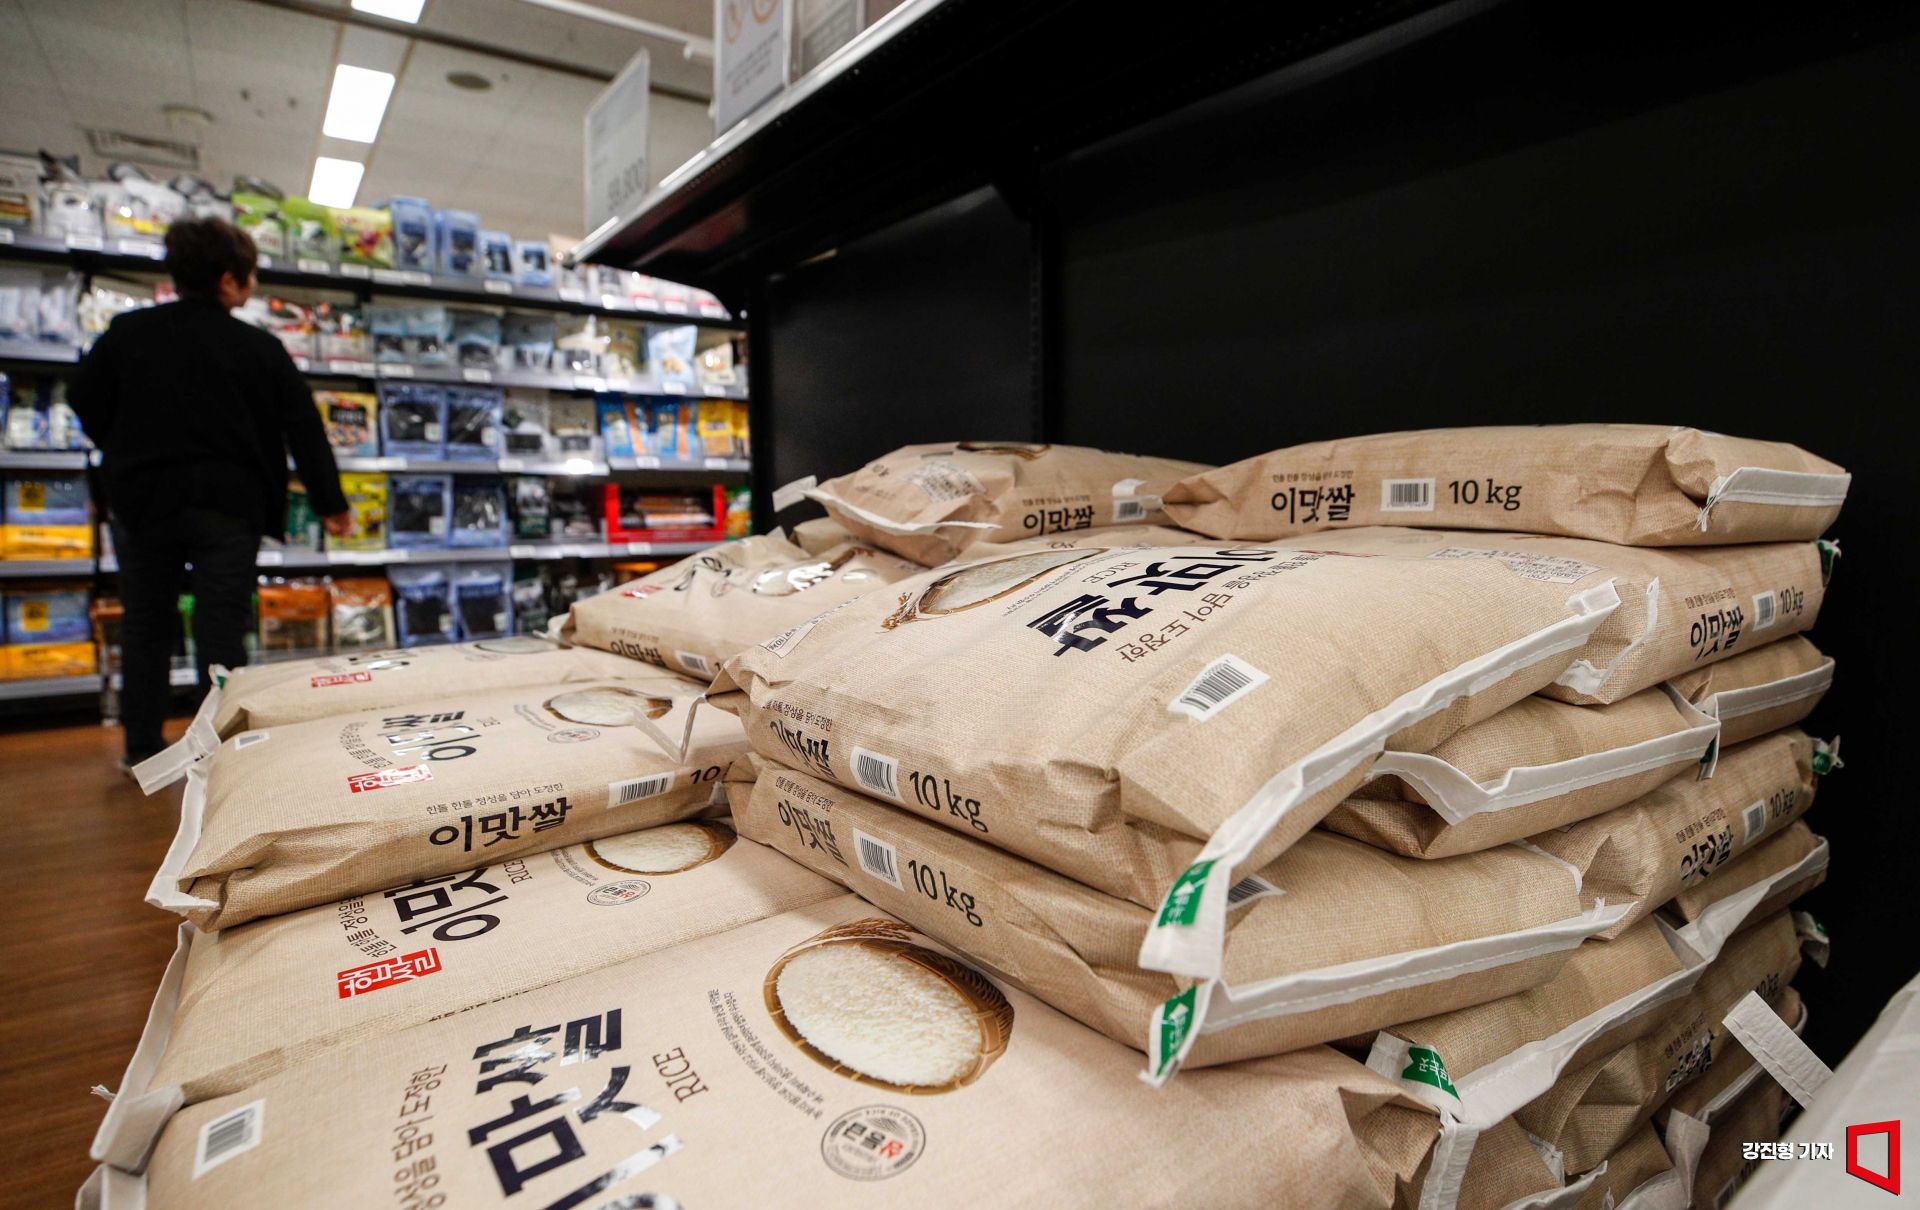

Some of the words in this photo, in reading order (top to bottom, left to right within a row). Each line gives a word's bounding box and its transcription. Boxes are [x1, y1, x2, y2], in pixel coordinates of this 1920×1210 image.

[1271, 484, 1356, 524] 이맛쌀
[1449, 479, 1479, 505] 10
[1485, 478, 1522, 511] kg
[1023, 505, 1095, 536] 이맛쌀
[1082, 561, 1141, 584] RICE
[1026, 549, 1278, 657] 이맛쌀
[1183, 593, 1234, 623] 담아
[1780, 589, 1792, 615] 10
[1115, 619, 1191, 663] 도정한
[1690, 605, 1744, 662] 이맛쌀
[475, 793, 508, 806] 정성을
[509, 788, 531, 800] 담아
[533, 782, 564, 794] 도정한
[690, 765, 721, 784] 10
[429, 796, 573, 852] 이맛쌀
[909, 771, 941, 811] 10
[944, 779, 989, 833] kg
[1770, 793, 1782, 818] 10
[778, 799, 849, 867] 이맛쌀
[503, 859, 532, 885] RICE
[908, 860, 938, 901] 10
[940, 870, 983, 928] kg
[384, 868, 509, 942] 이맛
[338, 948, 437, 997] 햅쌀
[400, 1064, 448, 1118] 도정한
[653, 1047, 709, 1103] RICE
[393, 1115, 435, 1161] 담아
